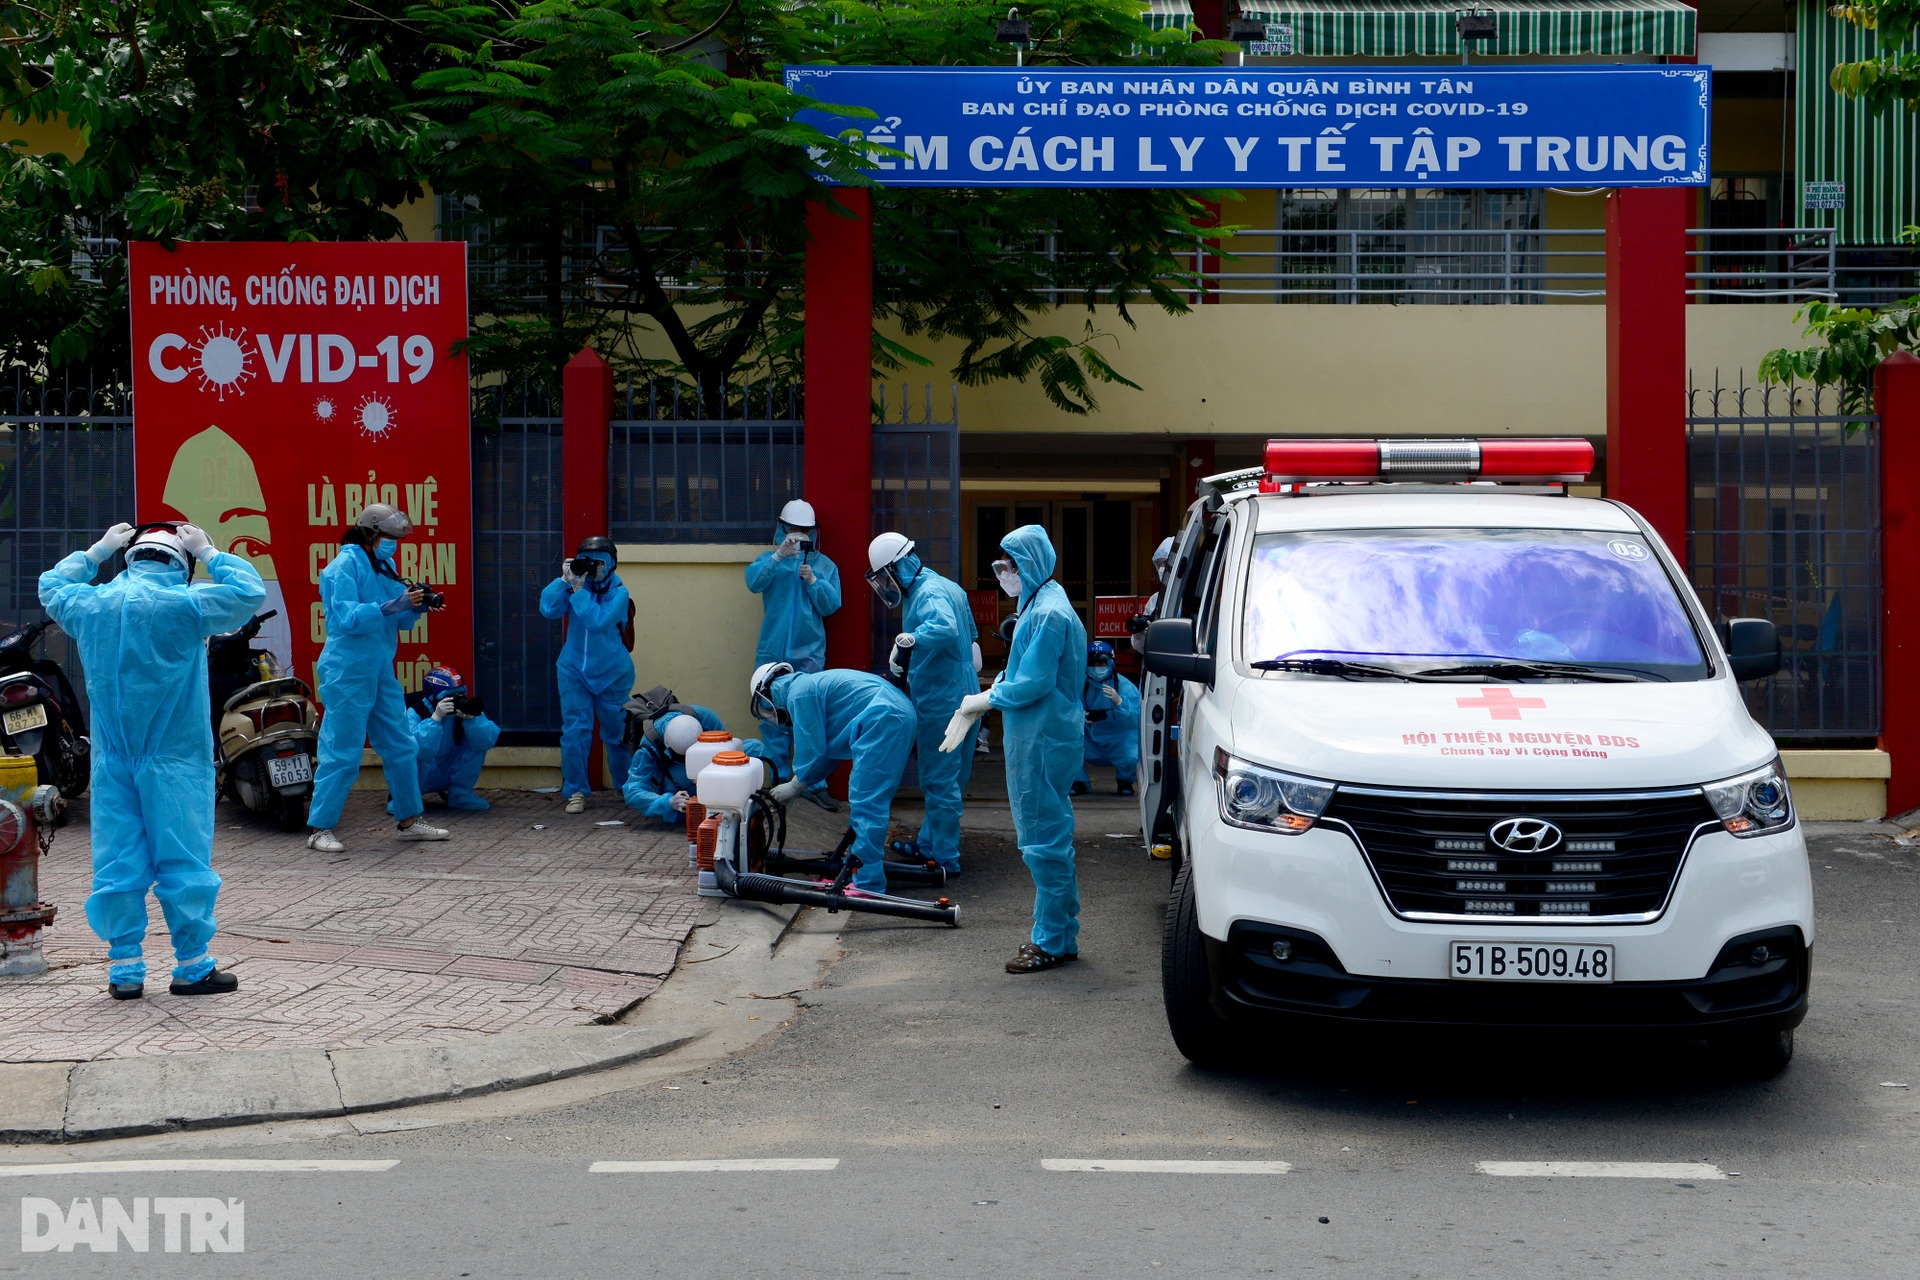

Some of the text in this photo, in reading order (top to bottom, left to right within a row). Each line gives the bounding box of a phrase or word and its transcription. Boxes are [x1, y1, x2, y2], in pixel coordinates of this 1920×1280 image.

[1017, 77, 1473, 97] ỦY BAN NHÂN DÂN QUẬN BÌNH TÂN
[962, 99, 1529, 119] BAN CHỈ ĐẠO PHÒNG CHỐNG DỊCH COVID-19
[968, 126, 1115, 172] CÁCH
[1138, 137, 1205, 172] LY
[1225, 137, 1260, 172] Y
[1278, 122, 1357, 173] TẾ
[1370, 127, 1481, 179] TẬP
[1498, 135, 1687, 172] TRUNG
[150, 264, 440, 311] PHÒNG, CHỐNG ĐẠI DỊCH
[149, 322, 434, 401] COVID-19
[308, 476, 338, 526] LÀ
[405, 476, 439, 536] VỆ
[1613, 543, 1643, 557] 03
[1099, 603, 1115, 614] KHU
[1099, 619, 1120, 632] CÁCH
[1402, 731, 1437, 746] HỘI
[1442, 730, 1503, 746] THIỆN
[1508, 732, 1593, 747] NGUYỆN
[1440, 747, 1485, 756] Chung
[1489, 747, 1510, 755] Tay
[1532, 747, 1568, 757] Cộng
[275, 757, 303, 771] 59-Y1
[274, 769, 309, 785] 660.53
[1456, 946, 1608, 977] 51B-509.48
